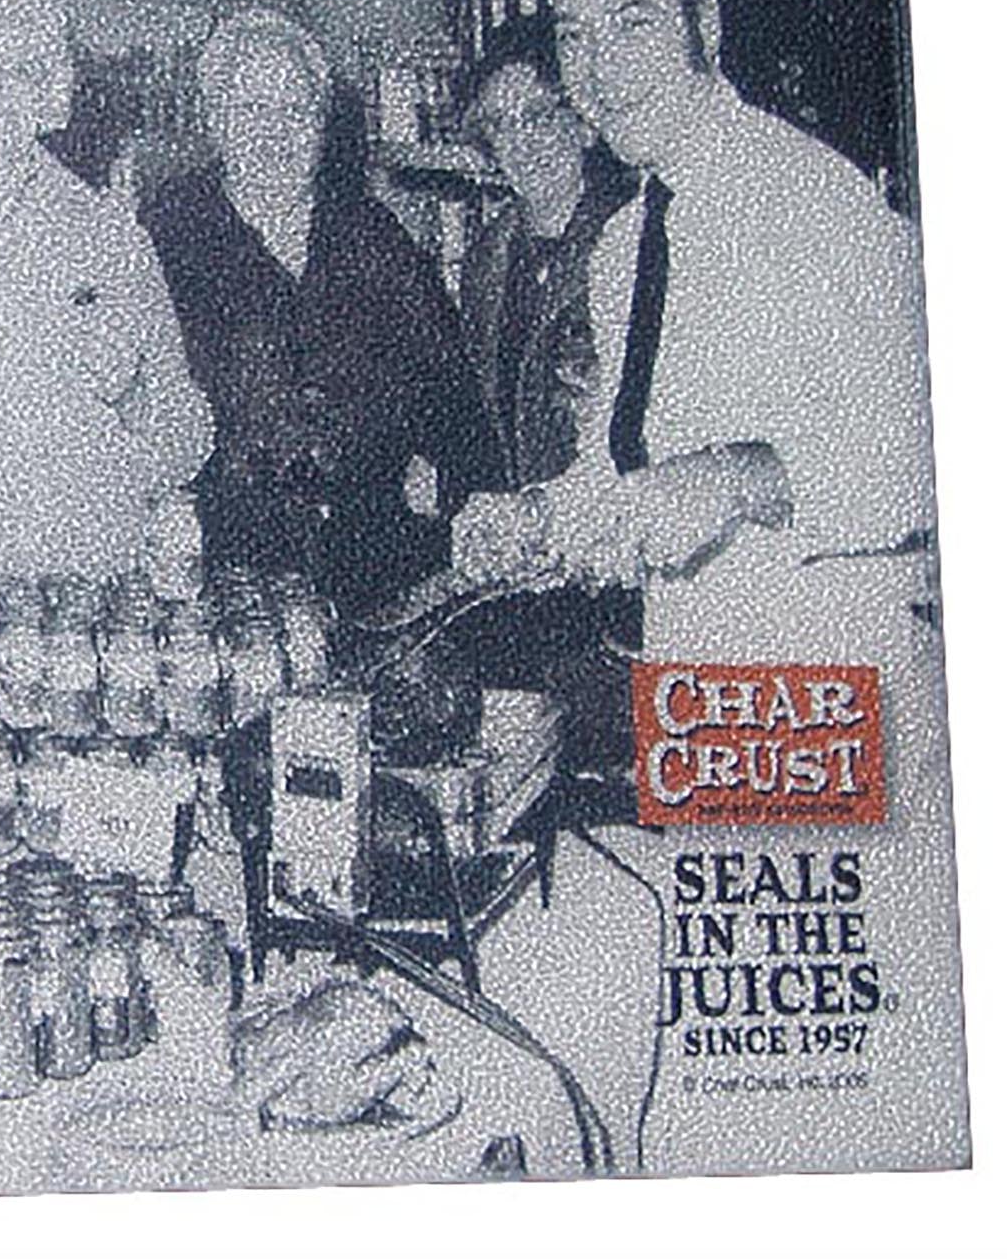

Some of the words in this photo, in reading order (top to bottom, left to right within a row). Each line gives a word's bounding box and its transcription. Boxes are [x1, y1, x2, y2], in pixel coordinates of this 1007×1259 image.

[654, 672, 864, 738] CHAR
[648, 739, 865, 806] CRUST
[673, 852, 863, 905] SEALS
[675, 913, 735, 958] IN
[755, 912, 866, 955] THE
[683, 1025, 788, 1056] SINCE
[799, 1022, 868, 1054] 1957
